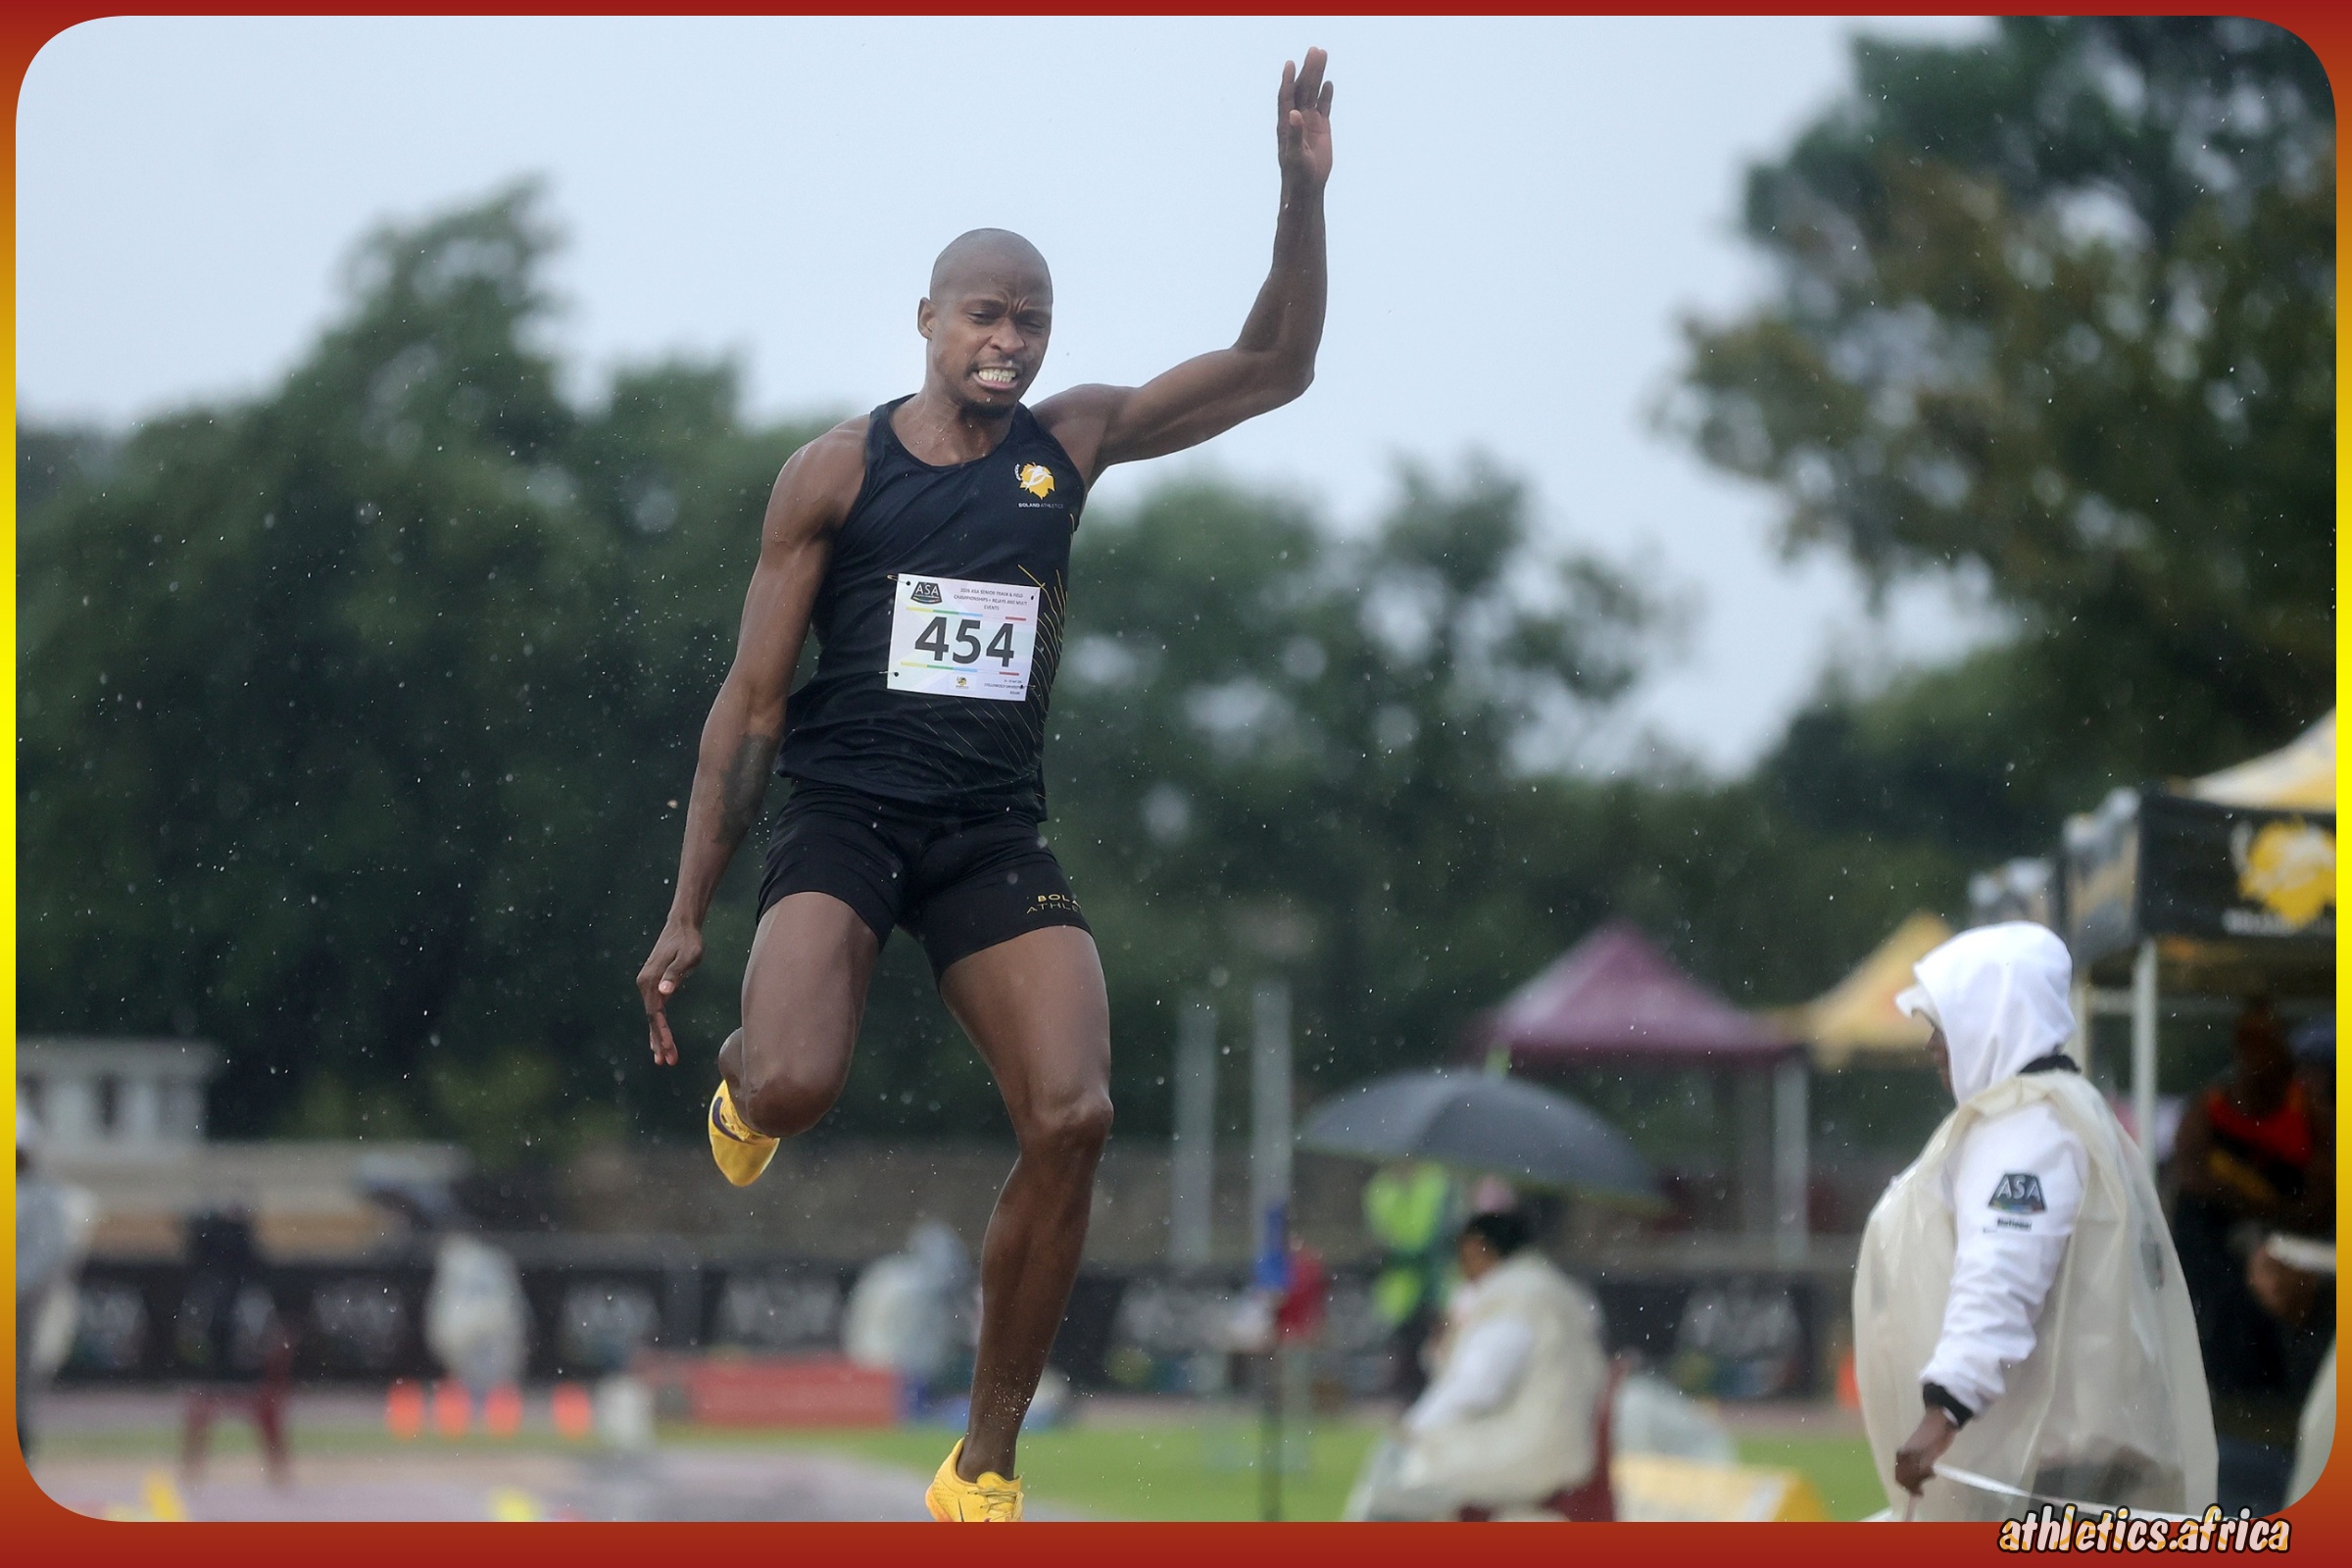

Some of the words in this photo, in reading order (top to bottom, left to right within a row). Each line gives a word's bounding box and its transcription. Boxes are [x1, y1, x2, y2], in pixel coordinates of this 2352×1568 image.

[915, 584, 939, 596] ASA
[914, 616, 1015, 668] 454
[1997, 1175, 2041, 1202] ASA
